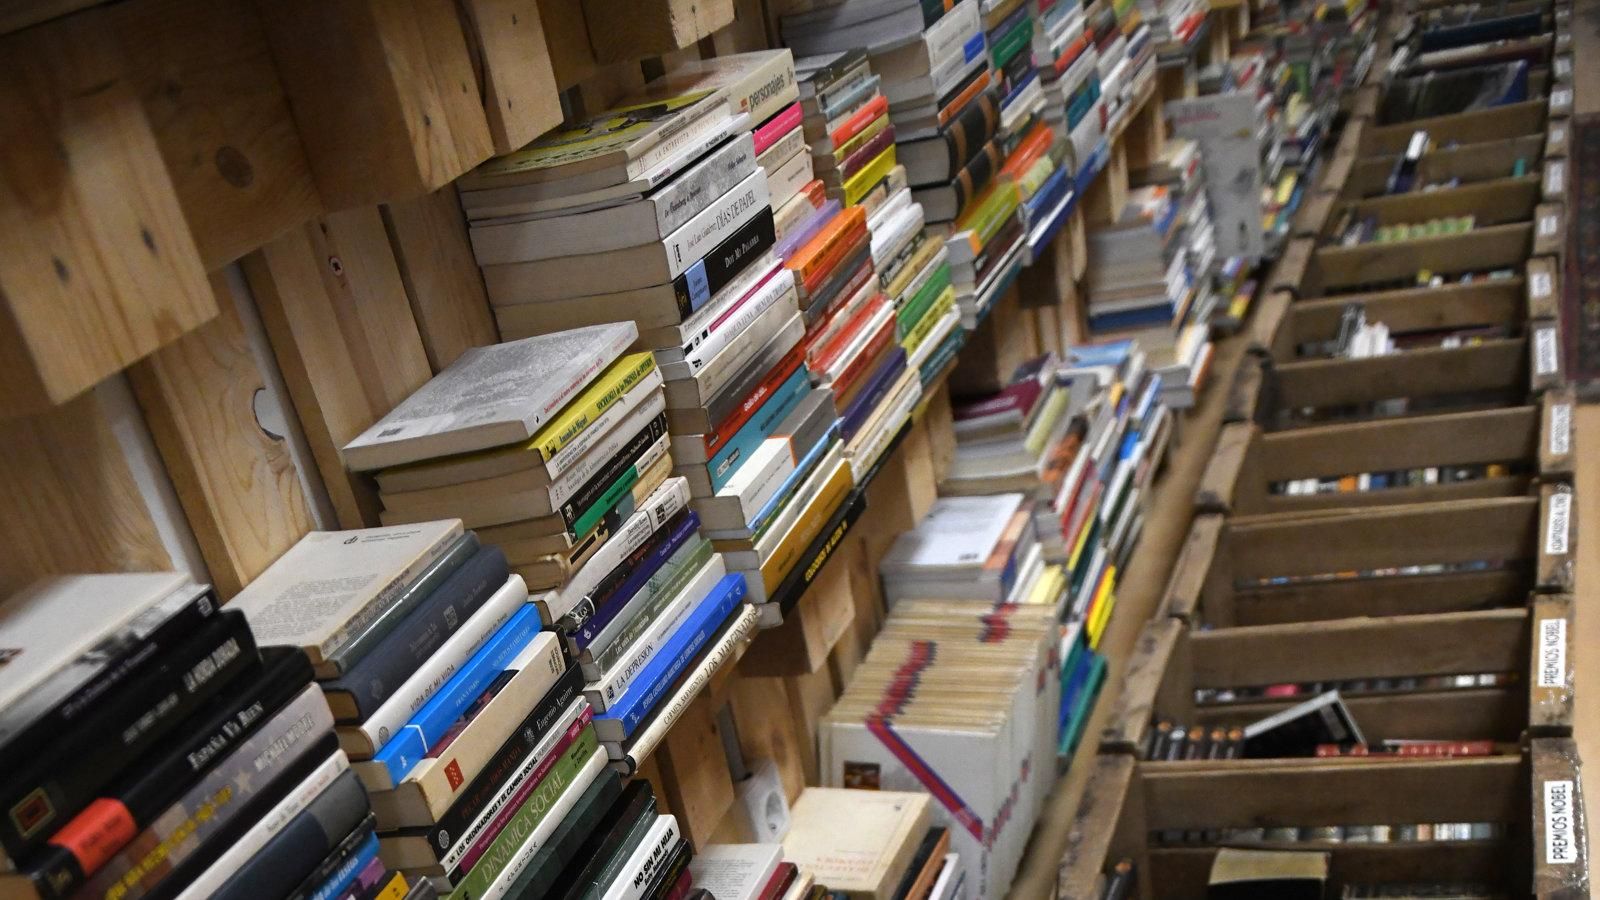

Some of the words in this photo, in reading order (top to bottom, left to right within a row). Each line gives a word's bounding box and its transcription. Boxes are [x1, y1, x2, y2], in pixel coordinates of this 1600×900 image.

[750, 74, 785, 112] personajes
[715, 208, 731, 231] DÍAS
[730, 203, 740, 221] DE
[738, 190, 756, 216] PAPEL
[1544, 620, 1561, 647] NOBEL
[410, 694, 426, 712] VIDA
[425, 685, 435, 700] DE
[434, 676, 442, 691] MI
[441, 662, 455, 683] VIDA
[616, 675, 626, 689] LA
[1543, 648, 1560, 685] PREMIOS
[663, 702, 682, 725] CARMEN
[681, 674, 704, 704] SARMIENTO
[704, 659, 718, 679] LOS
[456, 842, 466, 858] LOS
[465, 805, 499, 843] ORDENADORES
[506, 772, 524, 795] CAMBIO
[523, 756, 538, 776] SOCIAL
[1551, 783, 1567, 815] NOBEL
[480, 816, 532, 884] DINAMICA
[531, 771, 565, 820] SOCIAL
[1551, 816, 1569, 860] PREMIOS
[633, 871, 644, 890] NO
[643, 856, 654, 875] SIN
[653, 844, 662, 861] MI
[660, 827, 674, 849] HIJA
